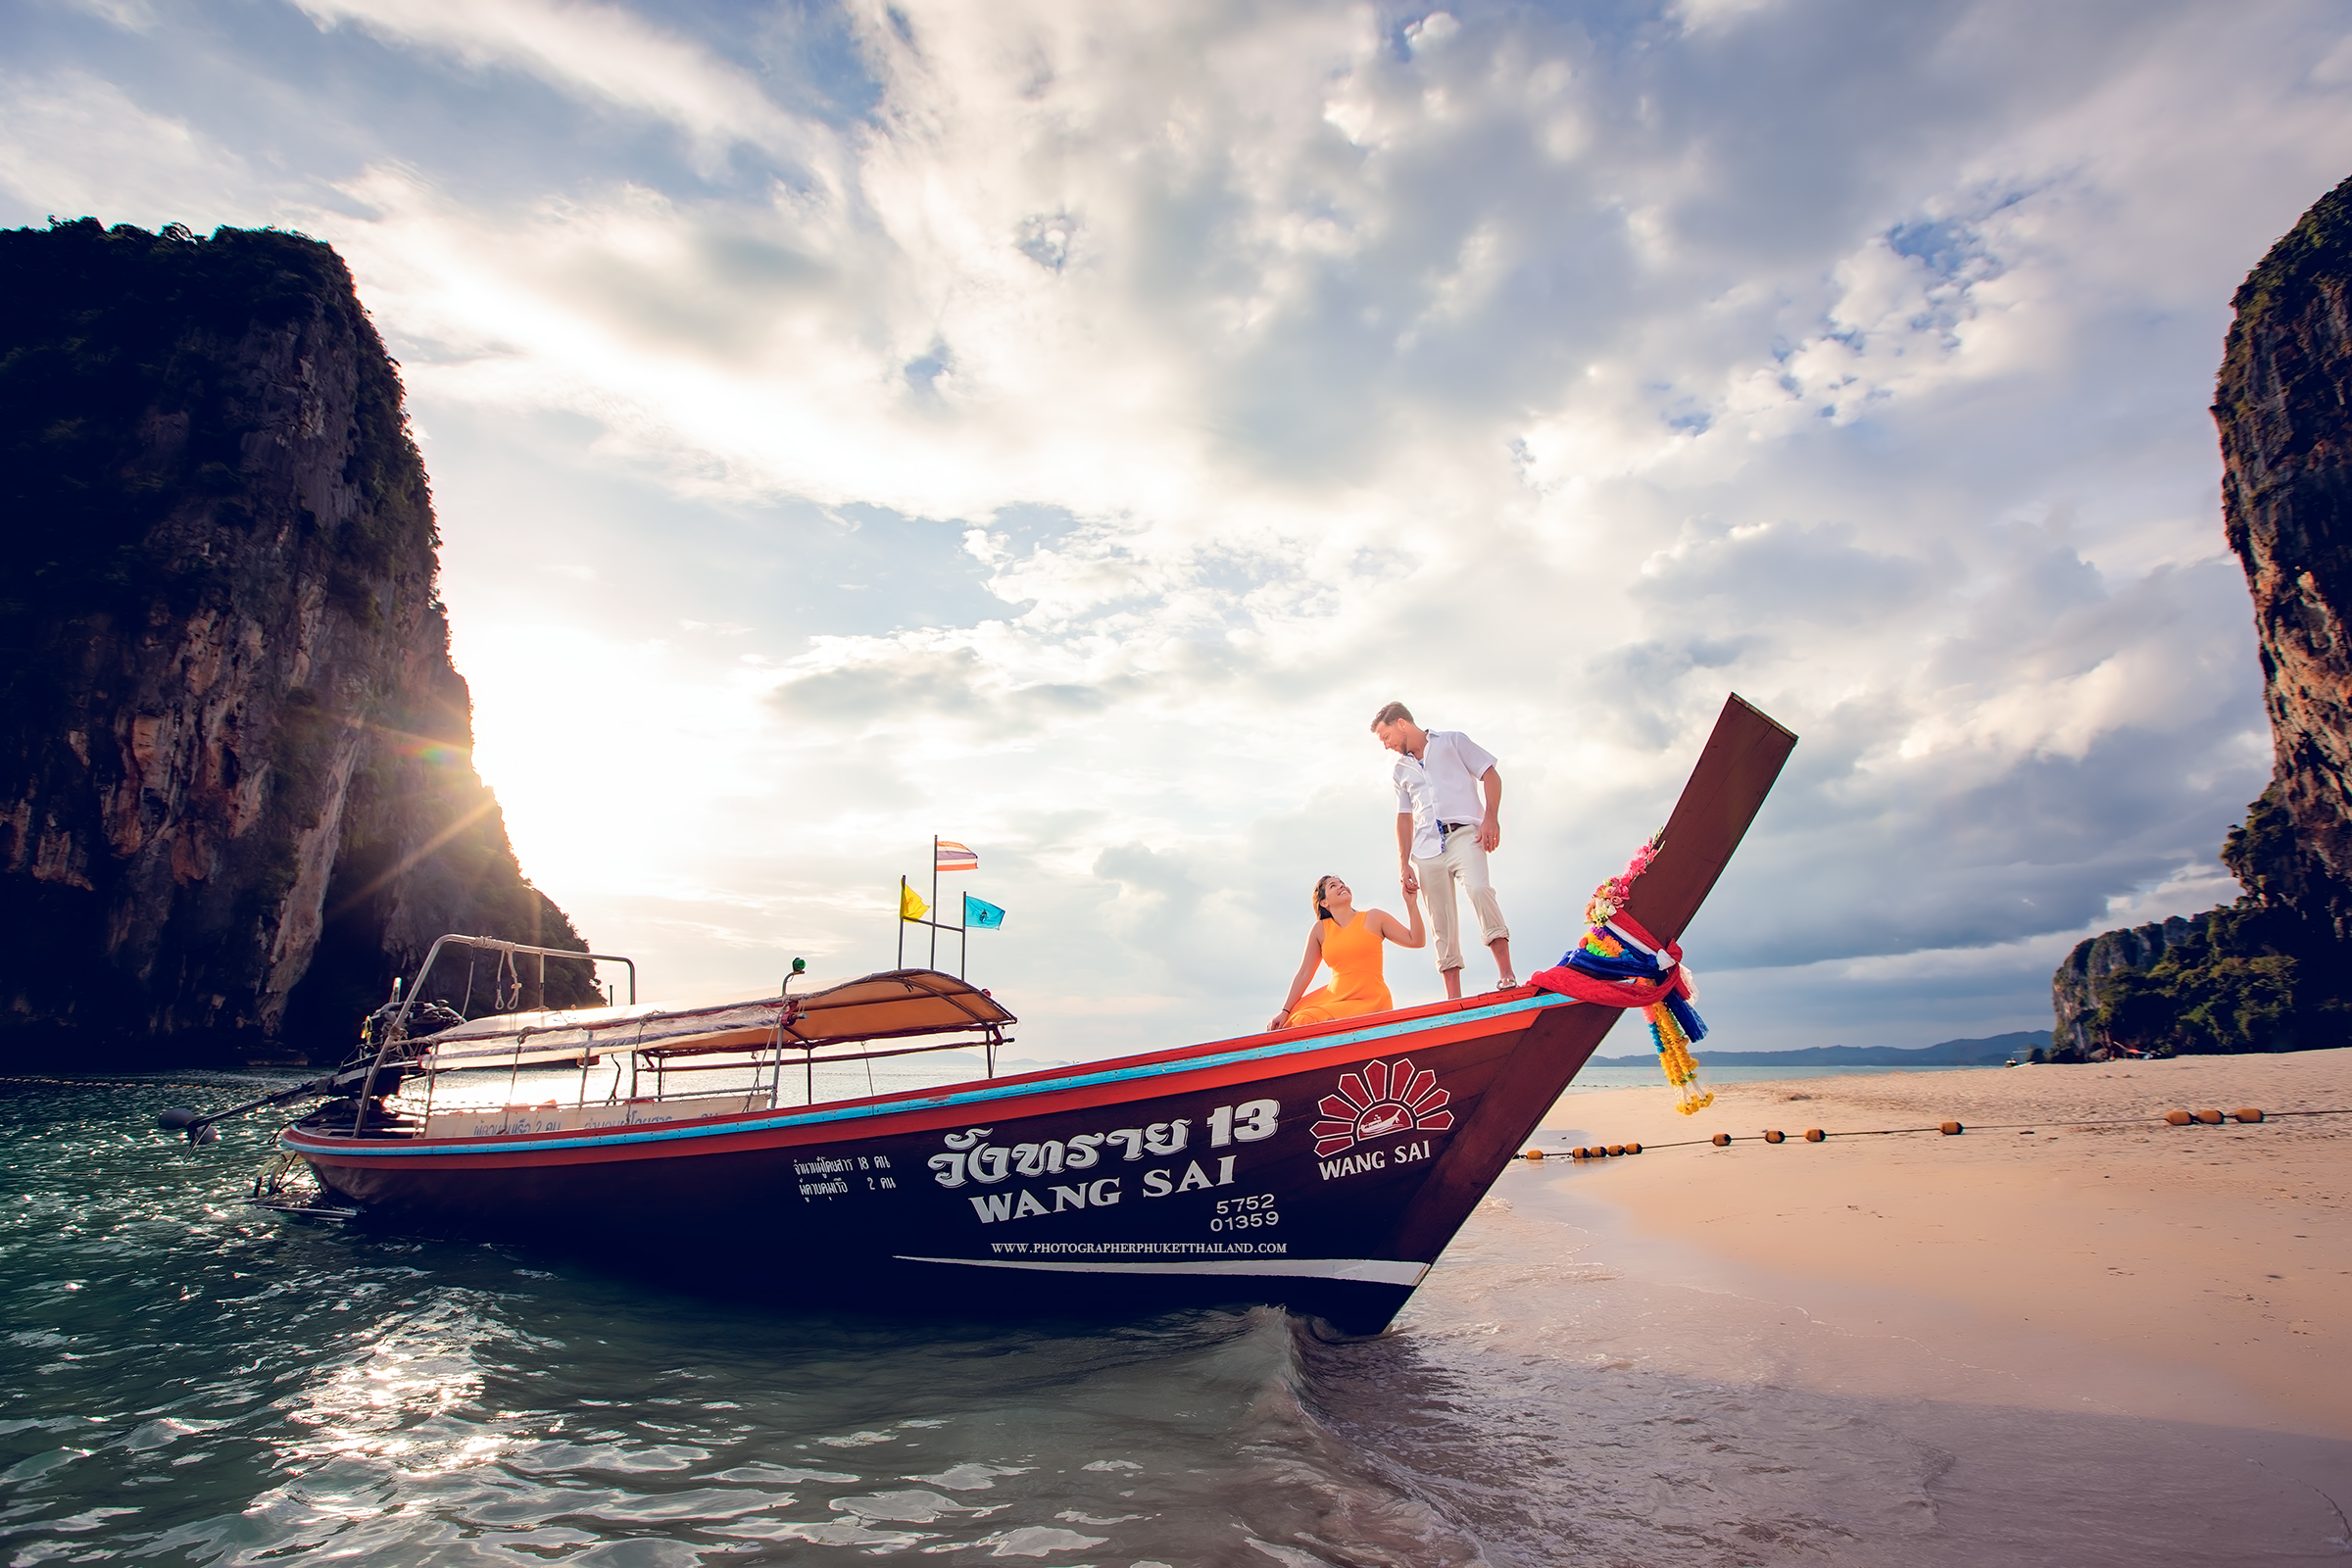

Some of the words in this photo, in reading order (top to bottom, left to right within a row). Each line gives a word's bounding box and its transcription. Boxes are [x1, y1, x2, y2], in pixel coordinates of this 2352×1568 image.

[927, 1118, 1193, 1189] วังทราย
[1206, 1099, 1281, 1149] 13
[858, 1156, 869, 1171] 18
[874, 1155, 891, 1169] คน
[1318, 1151, 1386, 1181] WANG
[1394, 1140, 1431, 1164] SAI
[866, 1177, 876, 1191] 2
[880, 1177, 897, 1190] คน
[968, 1177, 1122, 1224] WANG
[1143, 1154, 1237, 1199] SAI
[1216, 1193, 1275, 1215] 5752
[1209, 1210, 1280, 1232] 01359
